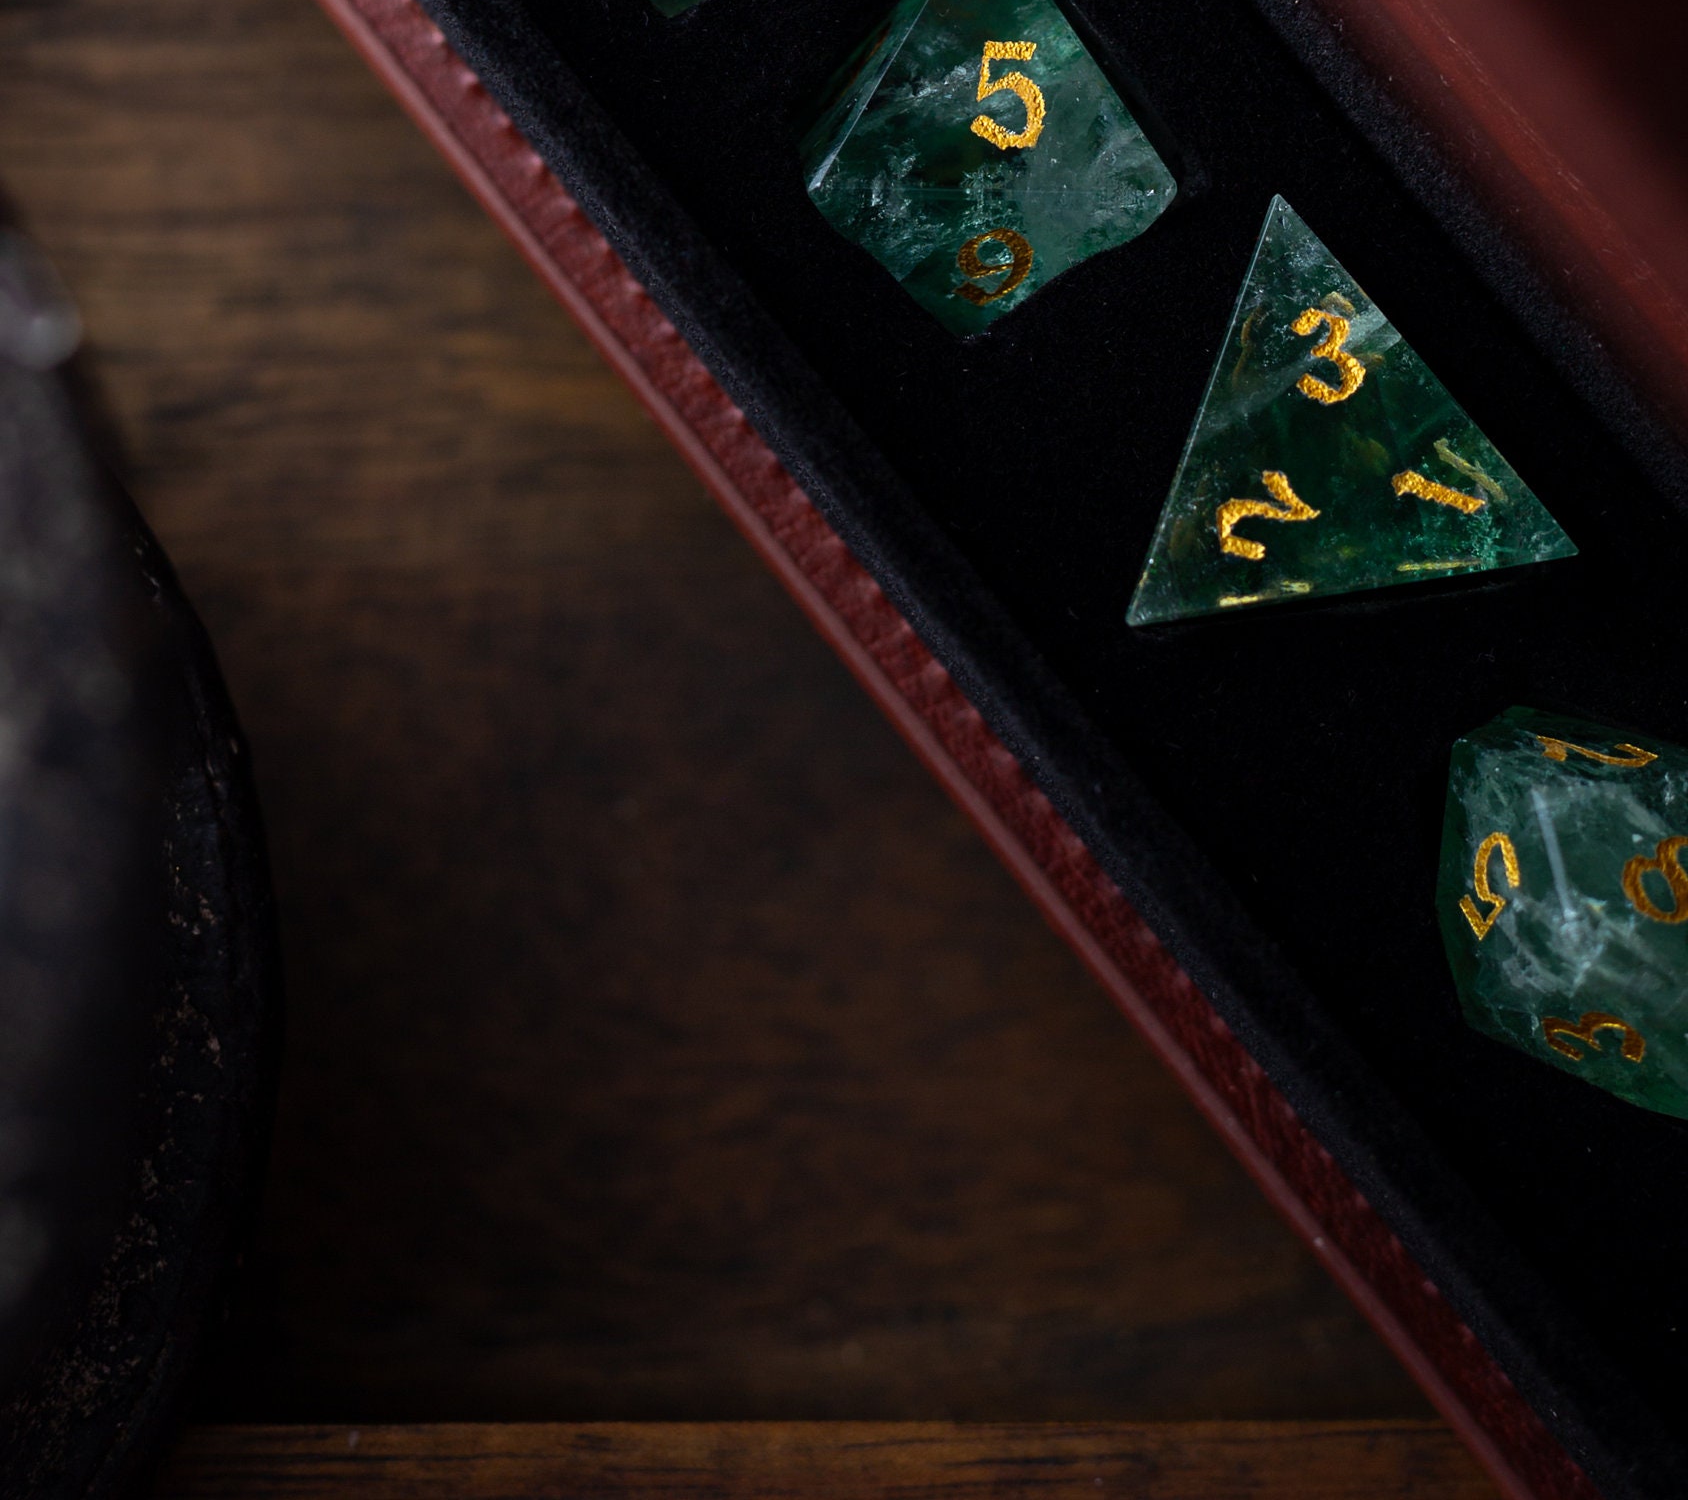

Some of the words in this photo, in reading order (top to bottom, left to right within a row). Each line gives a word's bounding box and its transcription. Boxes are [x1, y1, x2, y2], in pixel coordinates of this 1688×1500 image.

[970, 40, 1047, 150] 5
[1290, 307, 1367, 405] 3
[1215, 470, 1321, 561] 2
[1391, 469, 1486, 515] 1
[1458, 831, 1521, 941] 5
[1622, 835, 1688, 924] 8
[1541, 1011, 1647, 1064] 3
